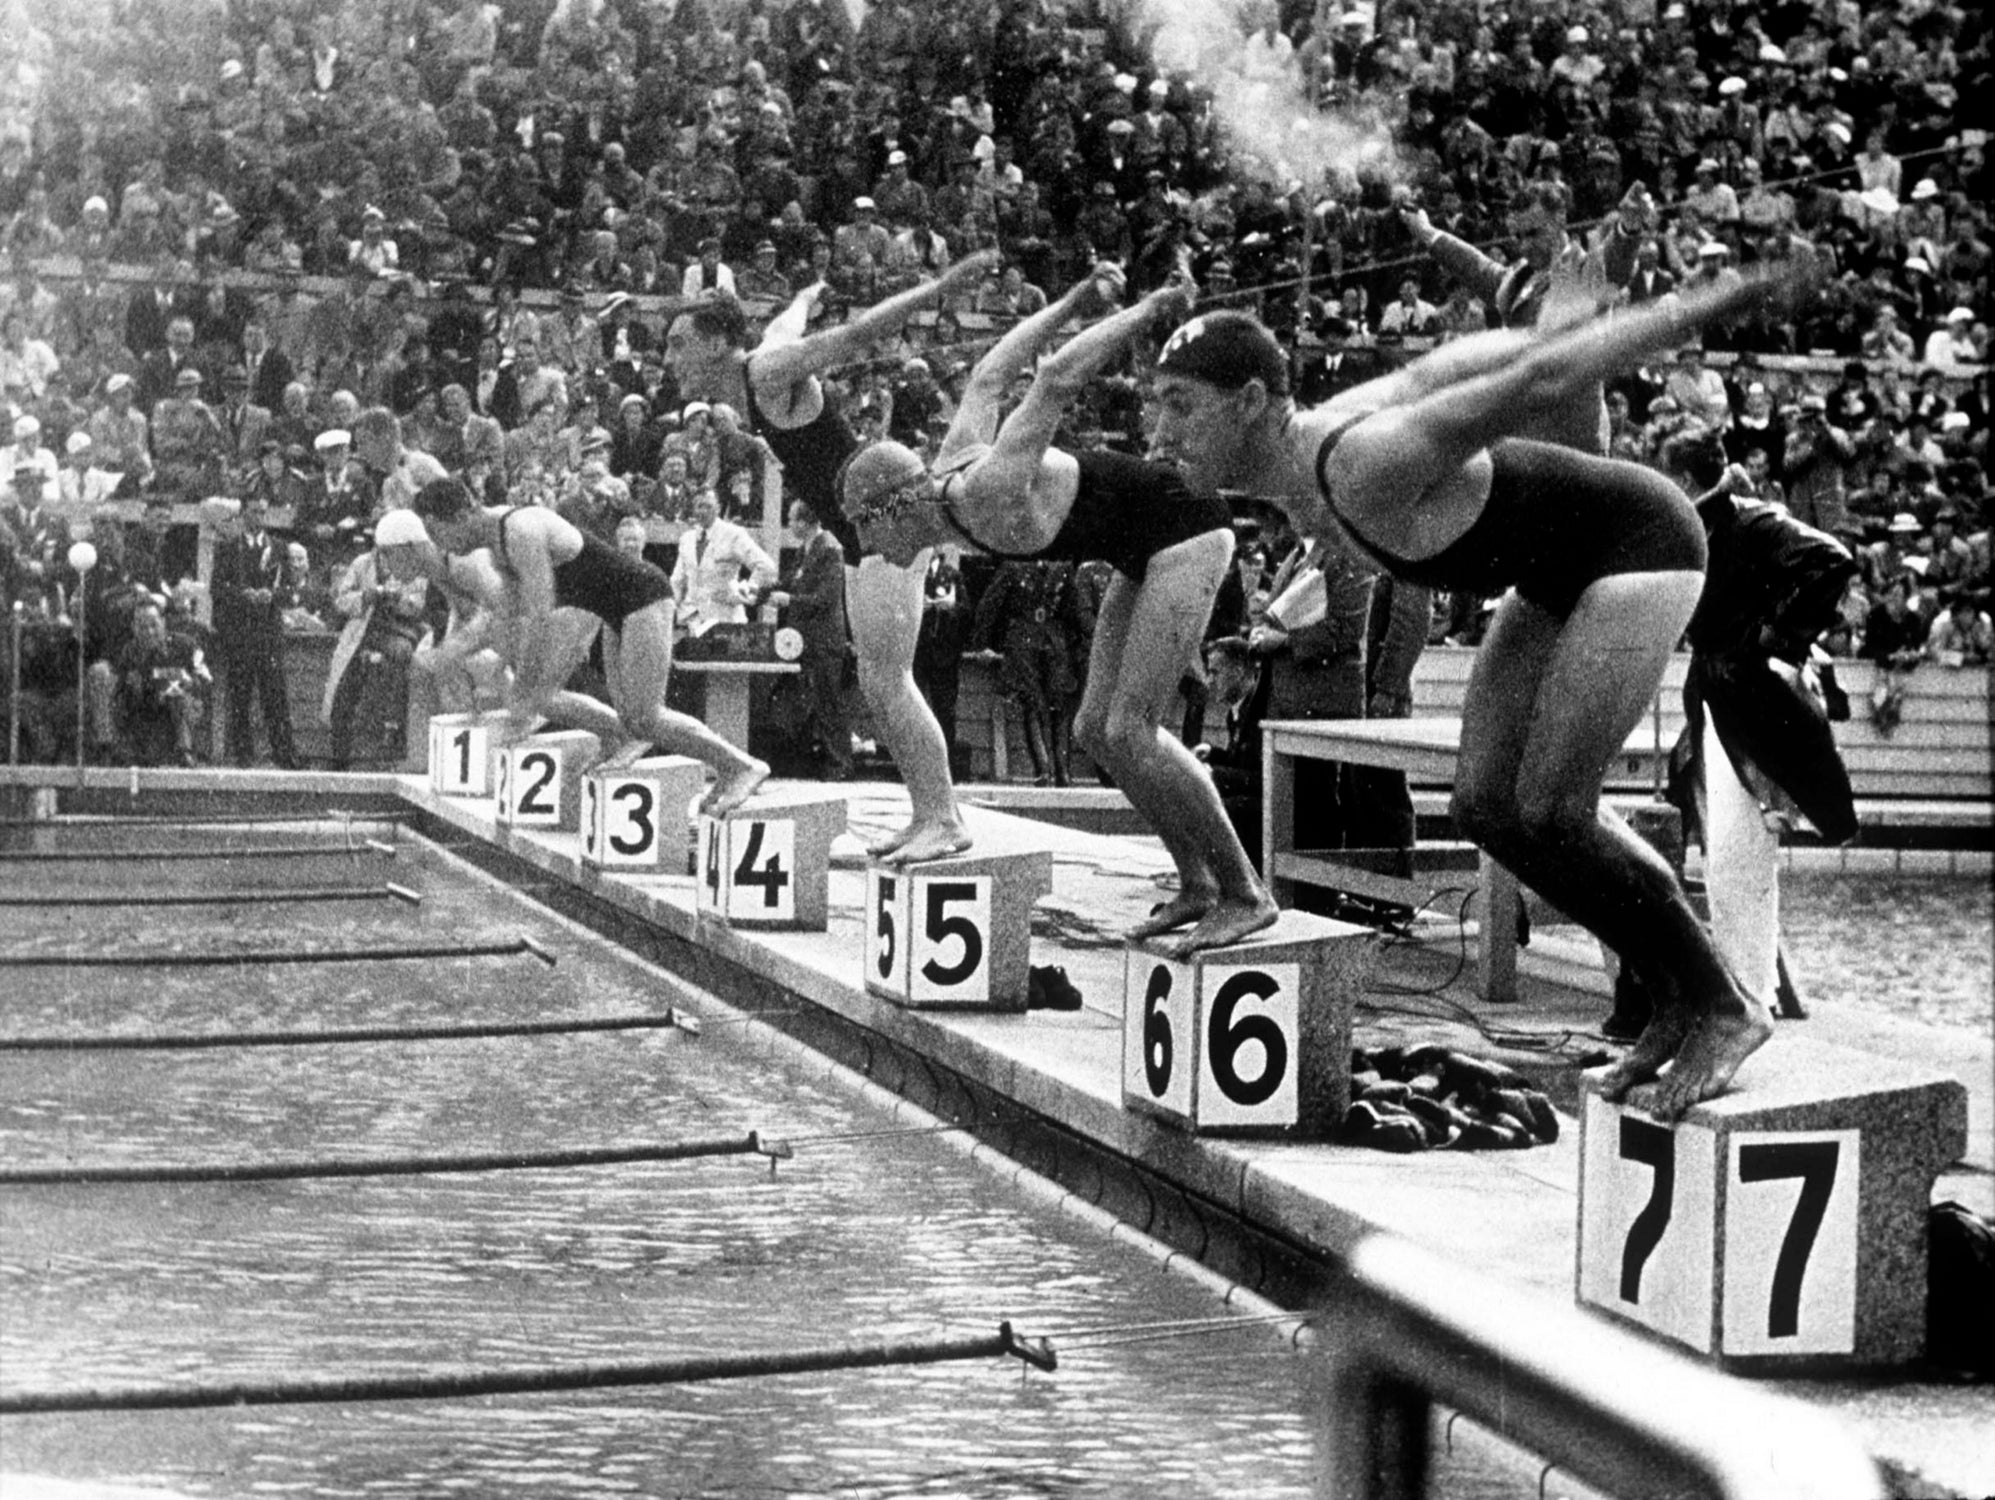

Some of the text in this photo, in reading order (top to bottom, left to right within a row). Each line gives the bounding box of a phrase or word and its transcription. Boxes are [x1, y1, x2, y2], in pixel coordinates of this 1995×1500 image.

[454, 730, 470, 784] 1
[518, 753, 556, 814] 2
[609, 783, 654, 855] 3
[734, 823, 788, 907] 4
[877, 876, 895, 978] 5
[921, 883, 982, 985] 5
[1144, 964, 1173, 1098] 6
[1208, 971, 1287, 1106] 6
[1620, 1115, 1675, 1304] 7
[1739, 1141, 1839, 1338] 7
